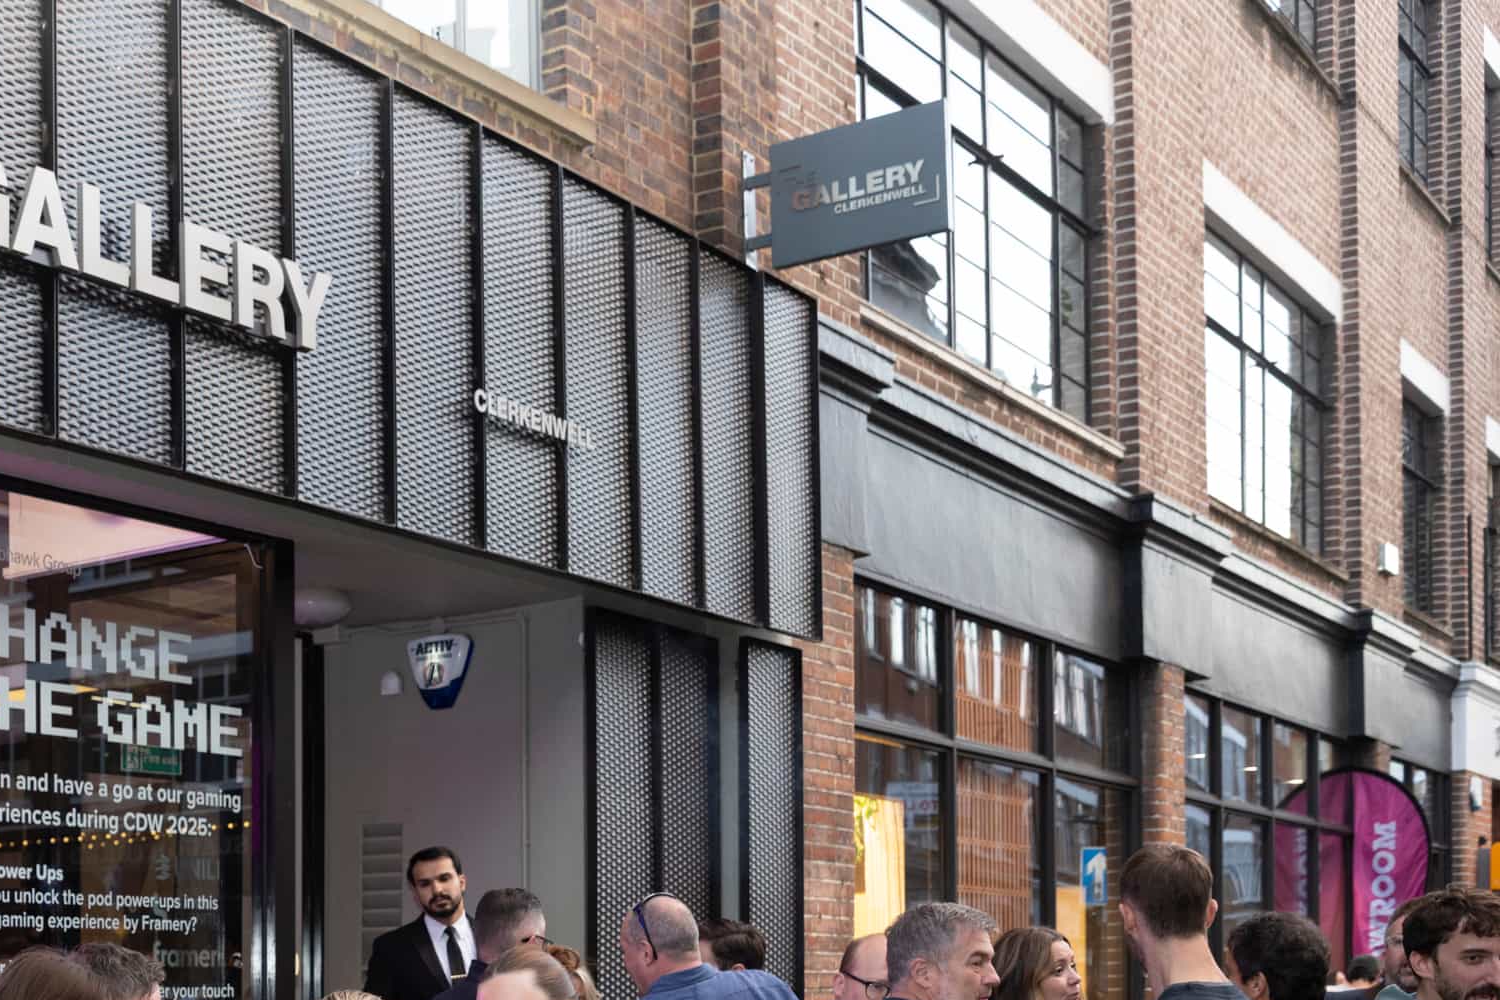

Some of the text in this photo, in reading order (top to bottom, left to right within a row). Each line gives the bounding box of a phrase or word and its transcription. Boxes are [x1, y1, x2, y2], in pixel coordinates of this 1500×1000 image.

[834, 184, 926, 214] CLERKENWELL
[474, 388, 597, 450] CLERKENWELL
[97, 690, 243, 757] GAME
[16, 772, 49, 792] and
[54, 773, 94, 796] have
[99, 782, 108, 797] a
[112, 783, 133, 802] go
[137, 784, 153, 801] at
[157, 787, 182, 803] our
[187, 790, 241, 813] gaming
[65, 808, 119, 834] during
[123, 812, 164, 832] CDW
[167, 816, 212, 837] 2025:
[36, 864, 64, 884] Ups
[14, 888, 59, 904] unlock
[62, 889, 84, 905] the
[88, 891, 113, 909] pod
[116, 895, 181, 912] power-ups
[184, 893, 195, 909] in
[198, 894, 219, 910] this
[1368, 821, 1397, 957] WROOM
[48, 914, 120, 932] experience
[123, 914, 139, 934] by
[141, 915, 197, 935] Framery?
[172, 986, 199, 1000] your
[202, 984, 235, 998] touch
